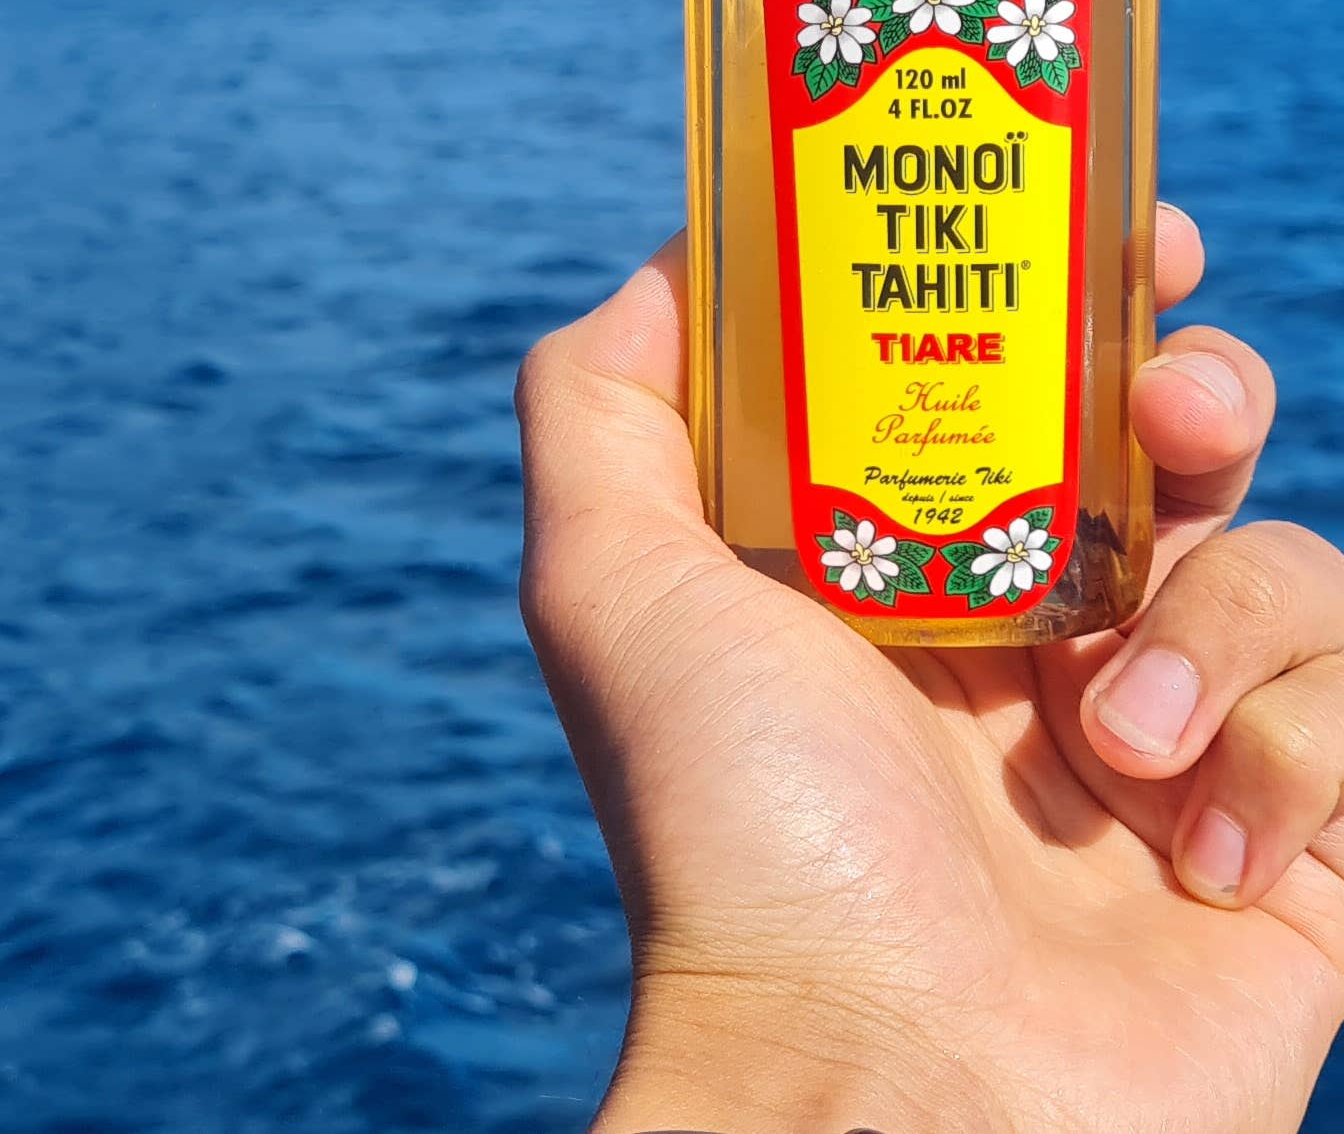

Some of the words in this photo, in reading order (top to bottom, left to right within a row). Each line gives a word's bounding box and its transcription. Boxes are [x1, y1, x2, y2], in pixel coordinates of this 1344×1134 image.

[895, 69, 933, 89] 120
[941, 68, 966, 89] ml
[888, 99, 901, 119] 4
[910, 98, 973, 119] FL.OZ
[843, 131, 1028, 195] MONOÏ
[876, 204, 988, 253] TIKI
[871, 333, 1005, 364] TIARE
[898, 382, 981, 411] Huile
[871, 414, 996, 457] Parfumée
[863, 466, 967, 490] Parfumerie
[975, 467, 1012, 485] Tiki
[901, 492, 935, 503] depuis
[948, 493, 975, 503] since
[913, 508, 963, 524] 1942
